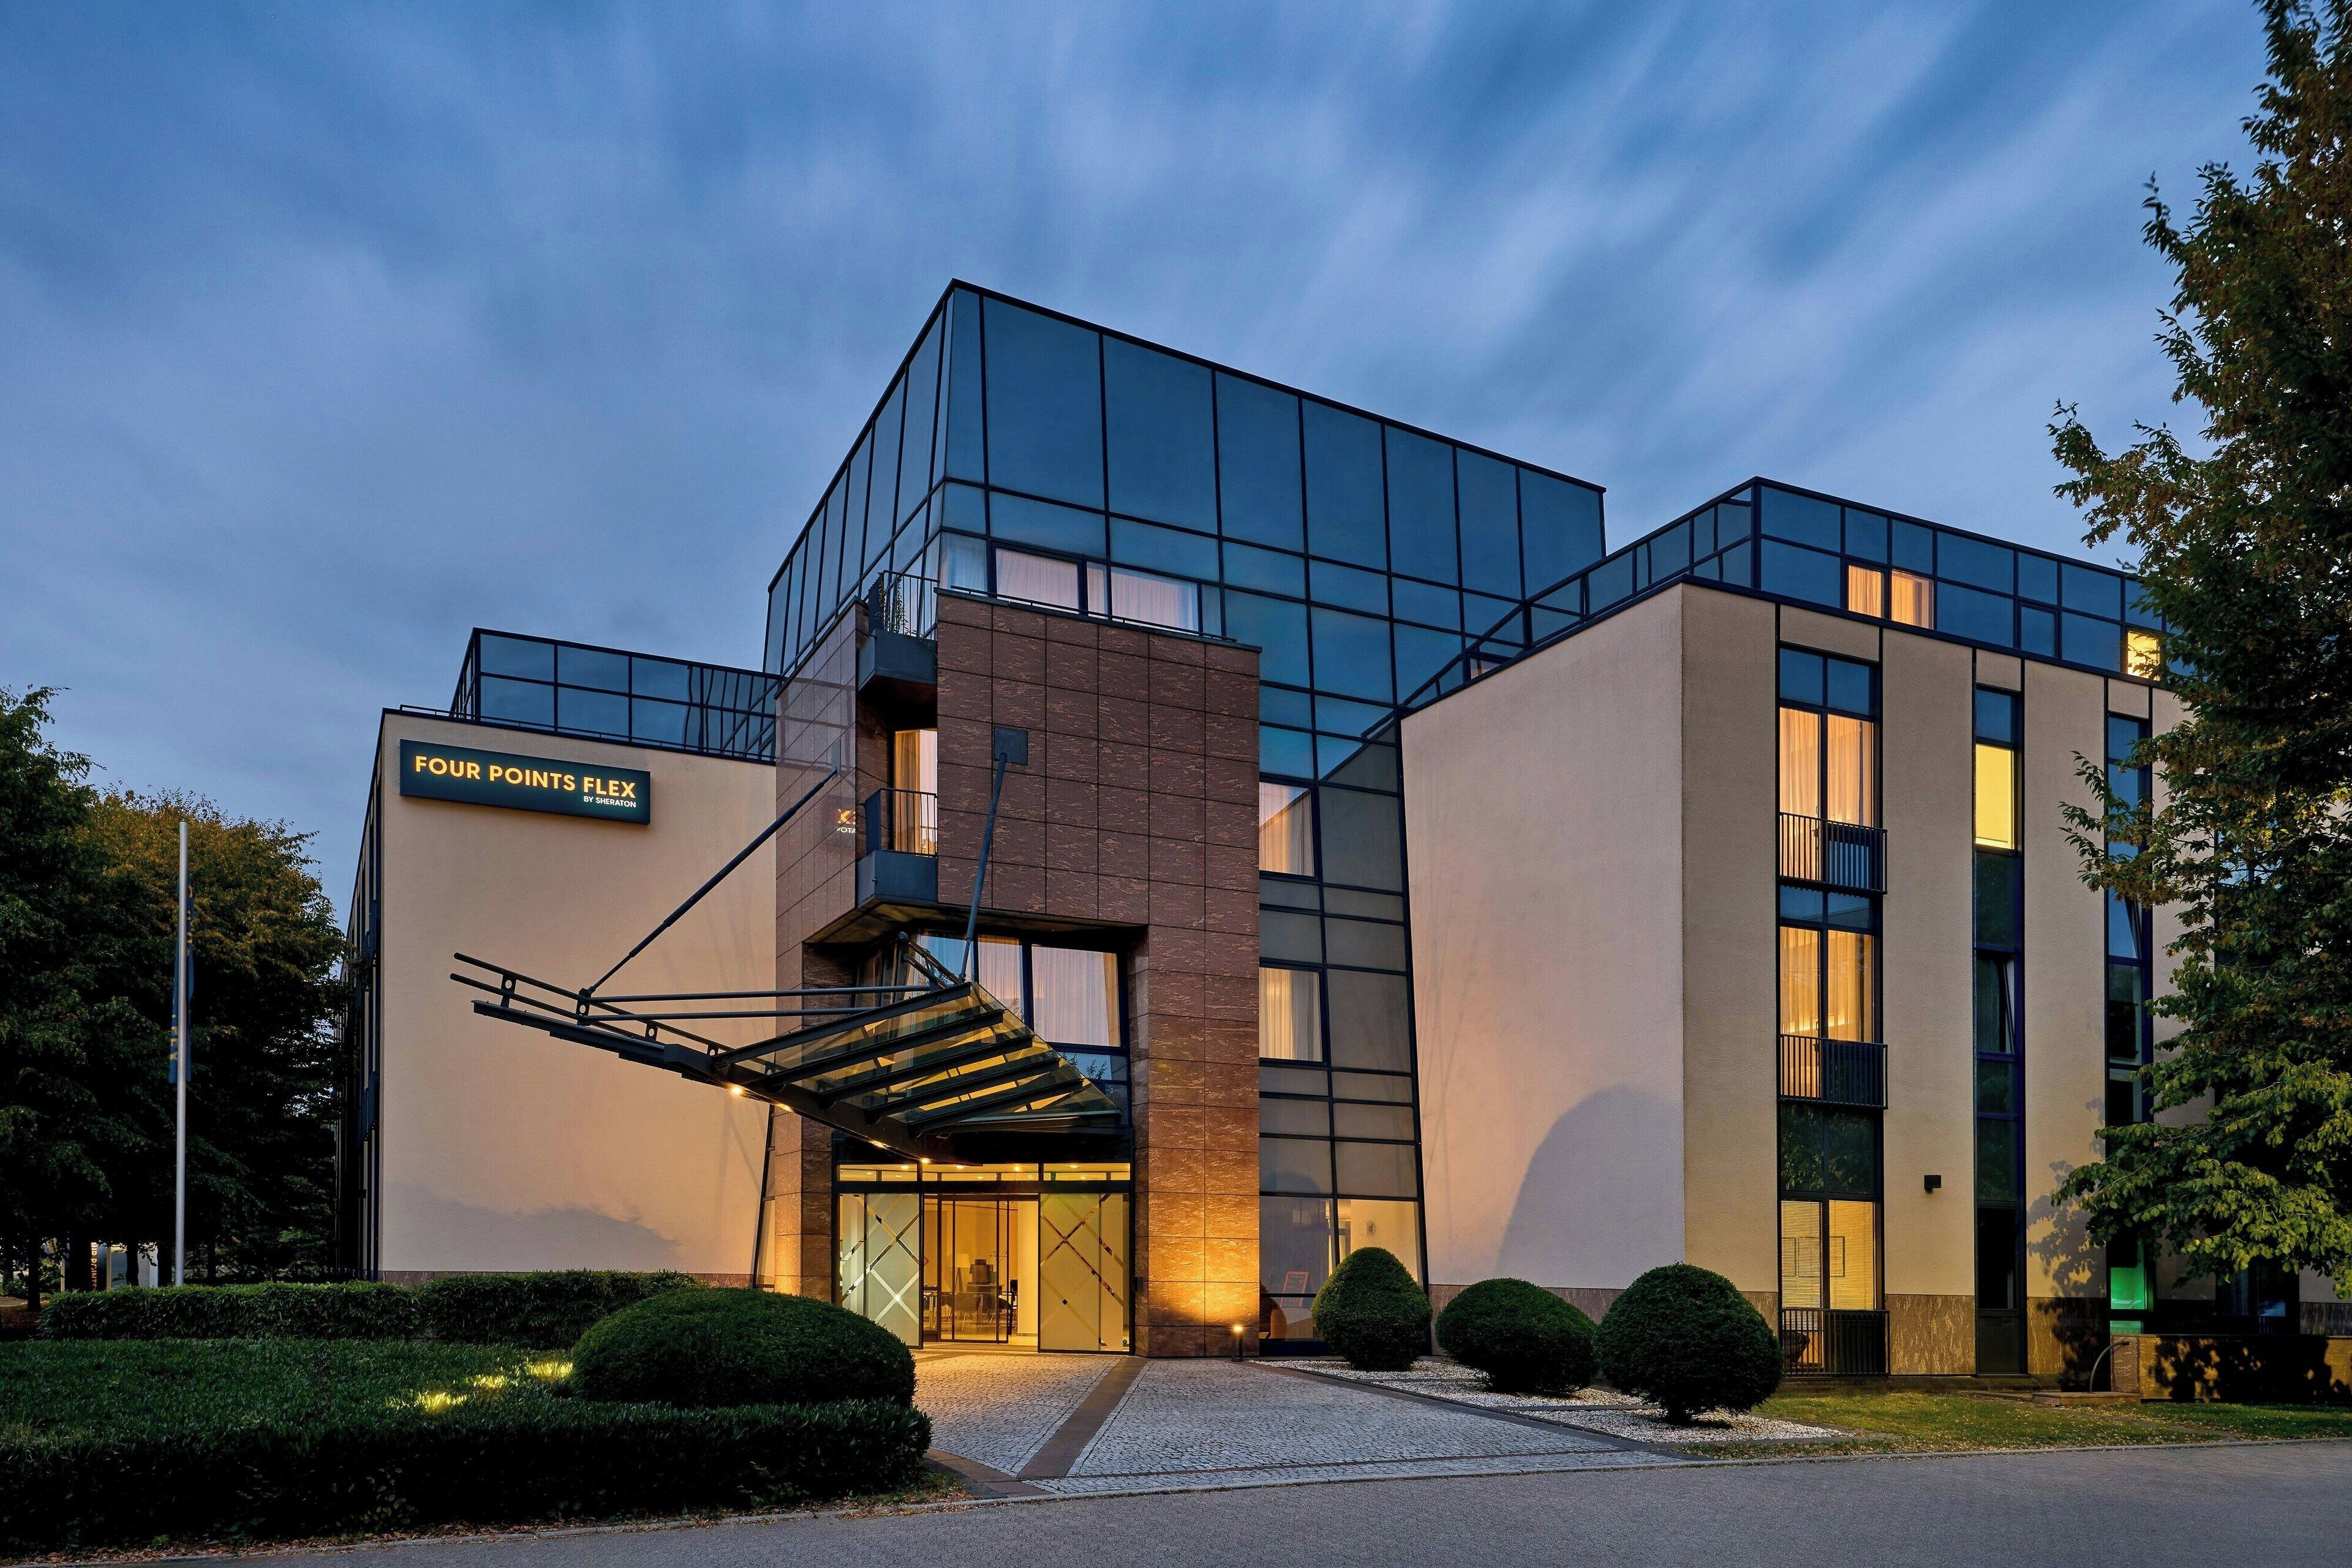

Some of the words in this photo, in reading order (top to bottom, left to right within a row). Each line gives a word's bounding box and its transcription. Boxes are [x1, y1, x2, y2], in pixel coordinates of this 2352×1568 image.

[415, 755, 481, 780] FOUR
[489, 764, 576, 792] POINTS
[583, 776, 636, 799] FLEX
[595, 796, 636, 808] SHERATON
